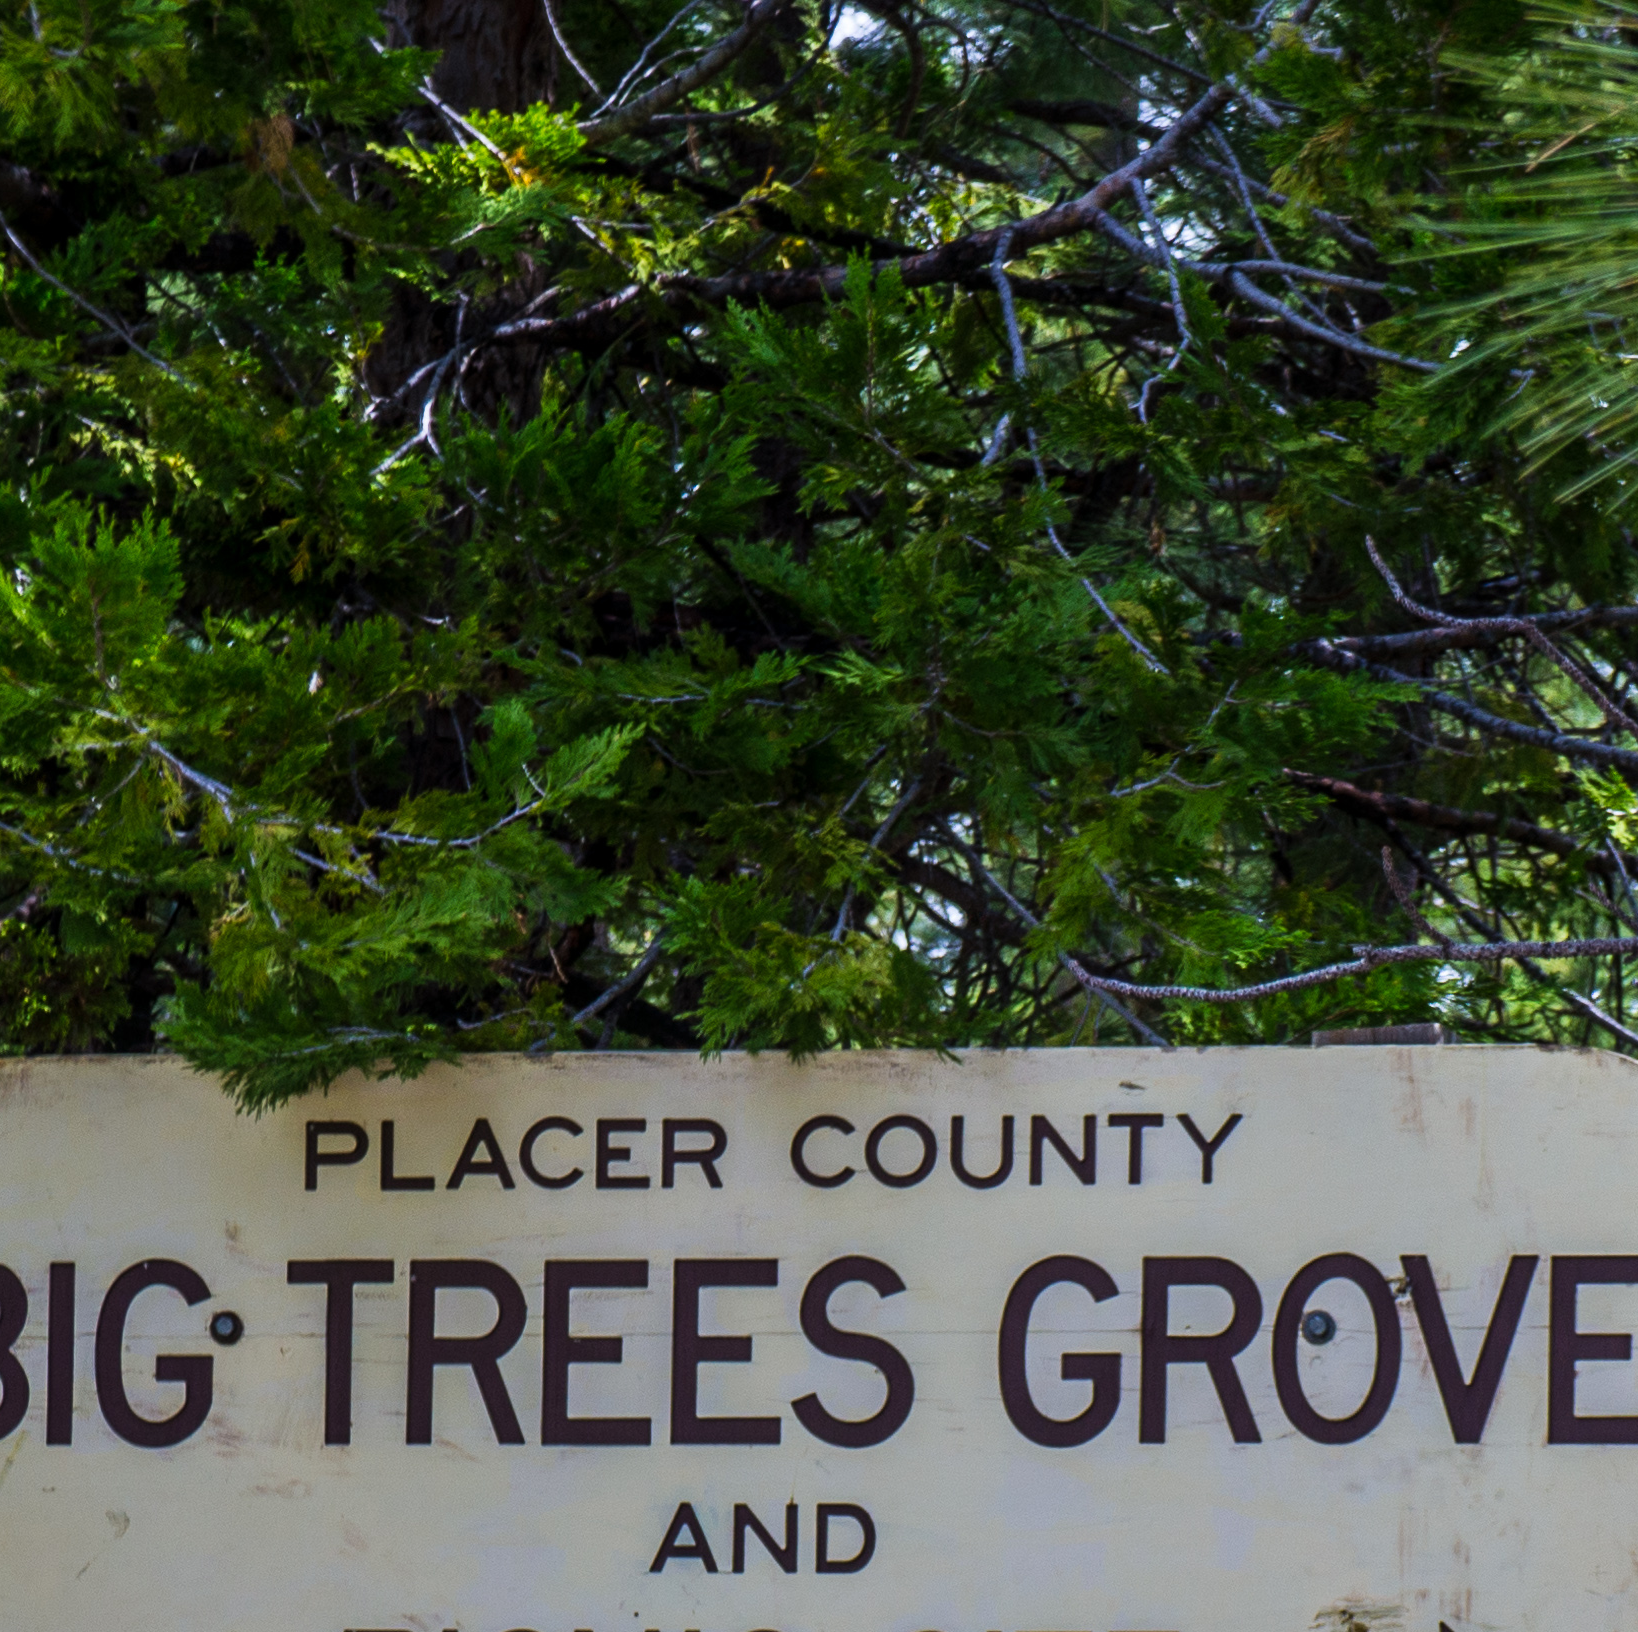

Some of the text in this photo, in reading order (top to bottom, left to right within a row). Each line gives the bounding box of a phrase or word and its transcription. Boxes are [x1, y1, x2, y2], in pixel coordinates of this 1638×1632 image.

[305, 1114, 1243, 1191] PLACER COUNTY
[287, 1256, 914, 1449] TREES
[649, 1501, 876, 1573] AND
